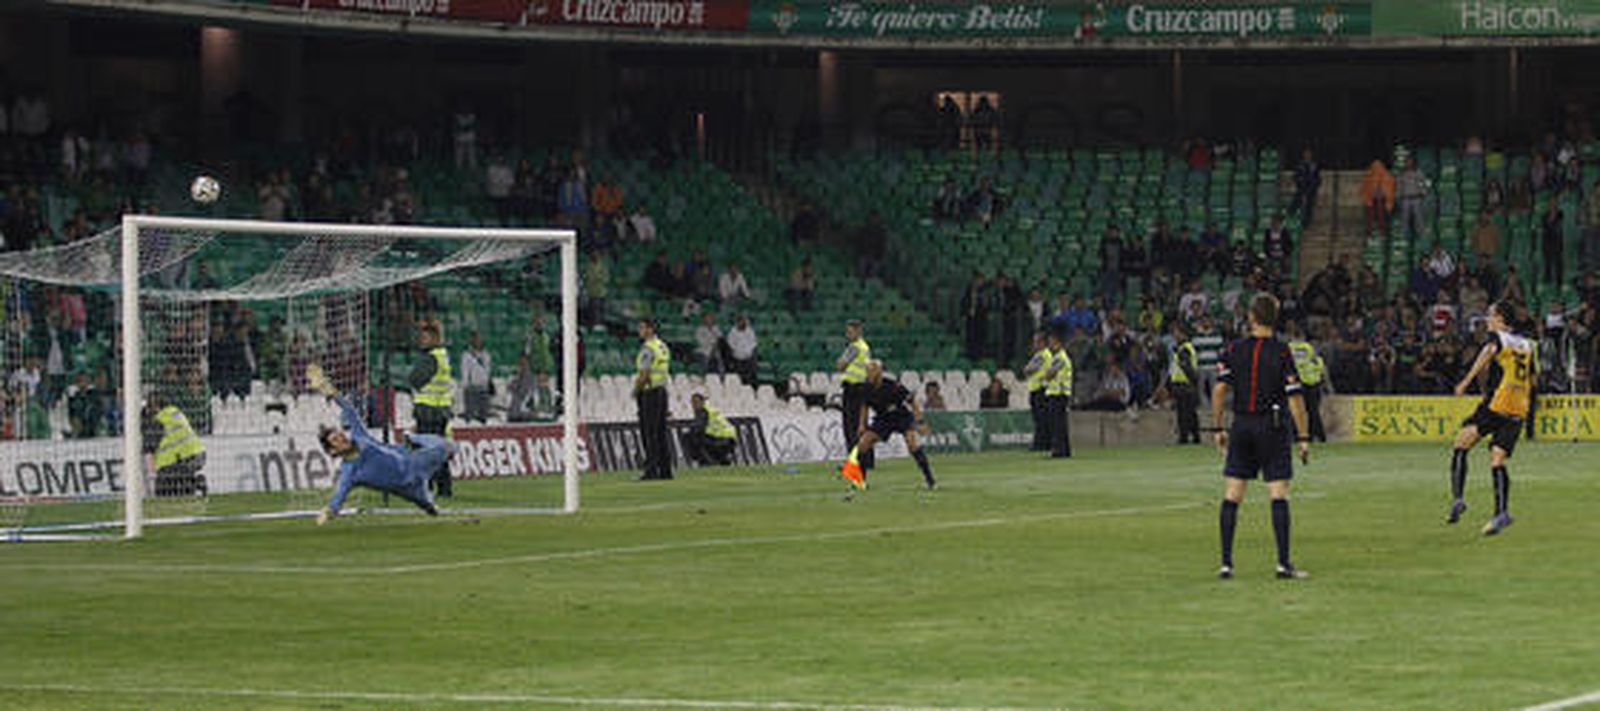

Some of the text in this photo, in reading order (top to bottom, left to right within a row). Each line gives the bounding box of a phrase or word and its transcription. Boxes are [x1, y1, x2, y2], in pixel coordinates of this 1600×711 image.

[871, 6, 960, 36] quiero
[1126, 5, 1273, 37] Cruzcampo
[449, 438, 528, 478] URGER
